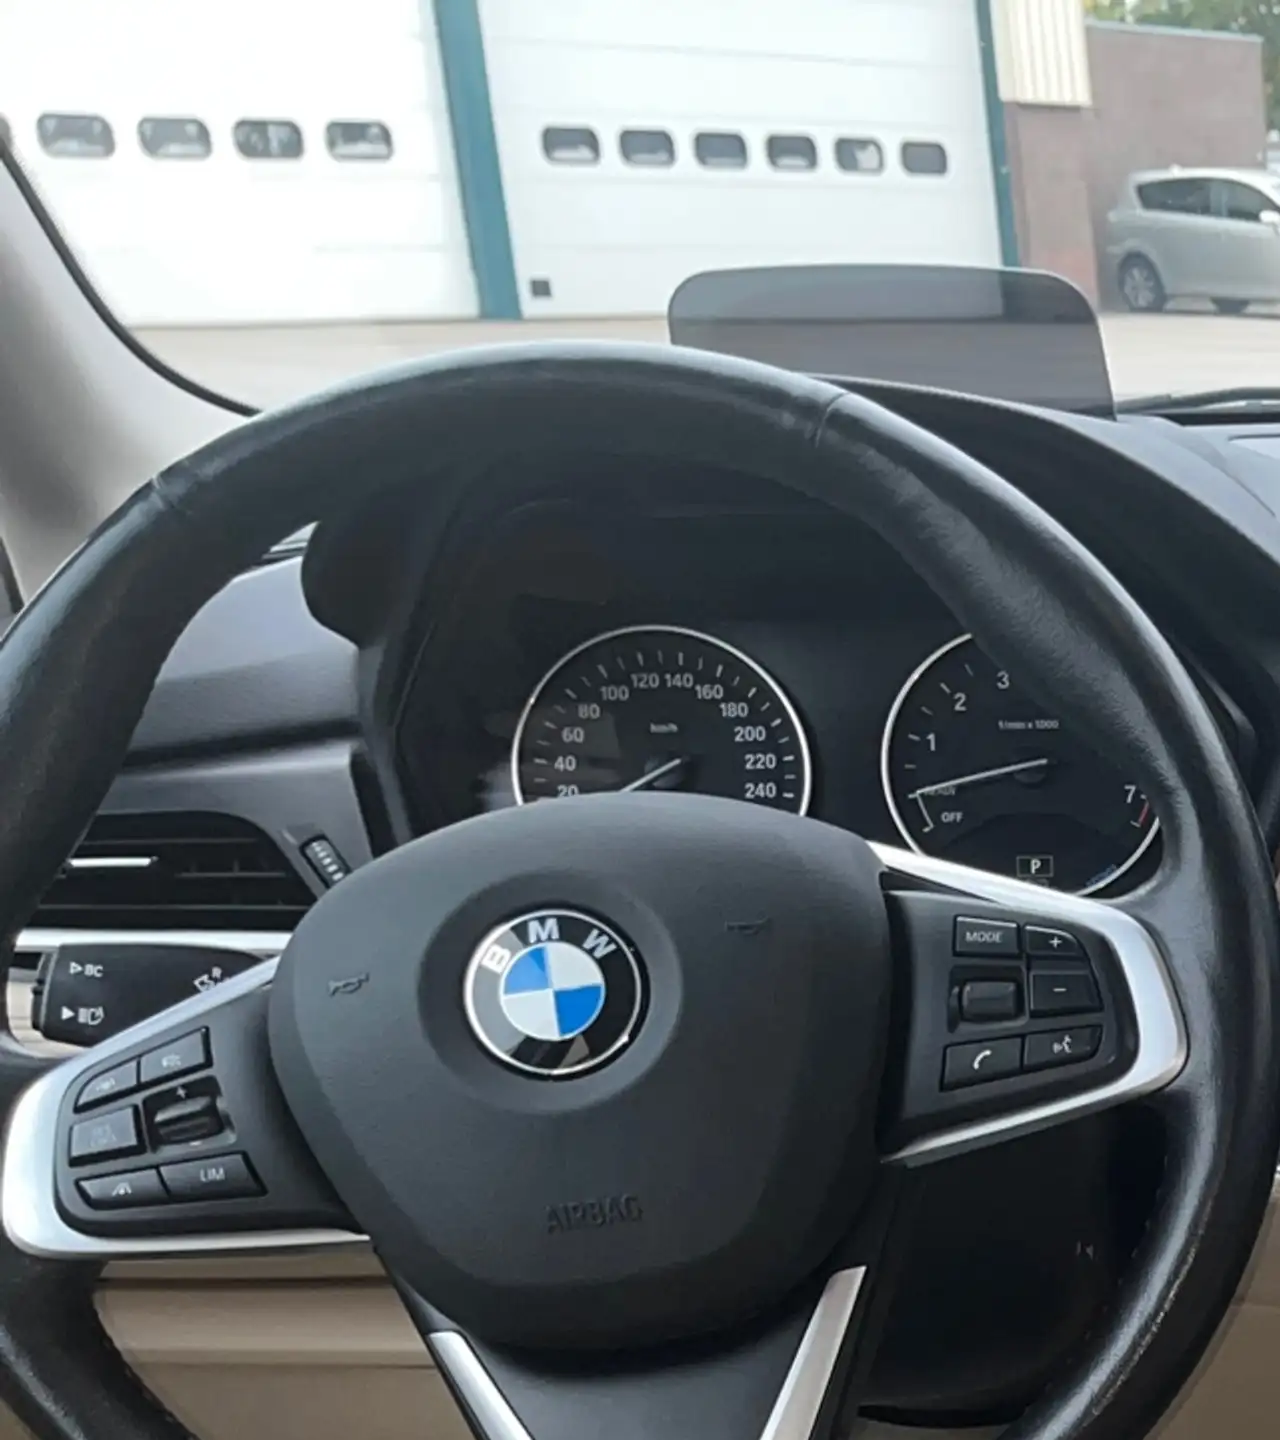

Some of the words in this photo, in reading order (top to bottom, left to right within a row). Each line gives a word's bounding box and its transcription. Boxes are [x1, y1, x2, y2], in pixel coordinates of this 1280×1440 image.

[631, 673, 659, 689] 120
[665, 673, 694, 689] 140
[996, 671, 1010, 689] 3
[600, 685, 629, 701] 100
[695, 684, 723, 700] 160
[719, 703, 748, 718] 180
[953, 693, 967, 712] 2
[578, 703, 600, 719] 80
[562, 727, 585, 743] 60
[734, 726, 766, 742] 200
[926, 733, 936, 751] 1
[554, 755, 576, 771] 40
[745, 754, 777, 770] 220
[558, 784, 579, 797] 20
[744, 782, 777, 798] 240
[1123, 785, 1137, 803] 7
[940, 811, 963, 823] OFF
[1030, 860, 1041, 873] P
[965, 931, 1003, 942] MODE
[481, 918, 618, 974] BMW
[200, 1168, 225, 1182] LIM
[546, 1196, 644, 1234] AIRBAG
